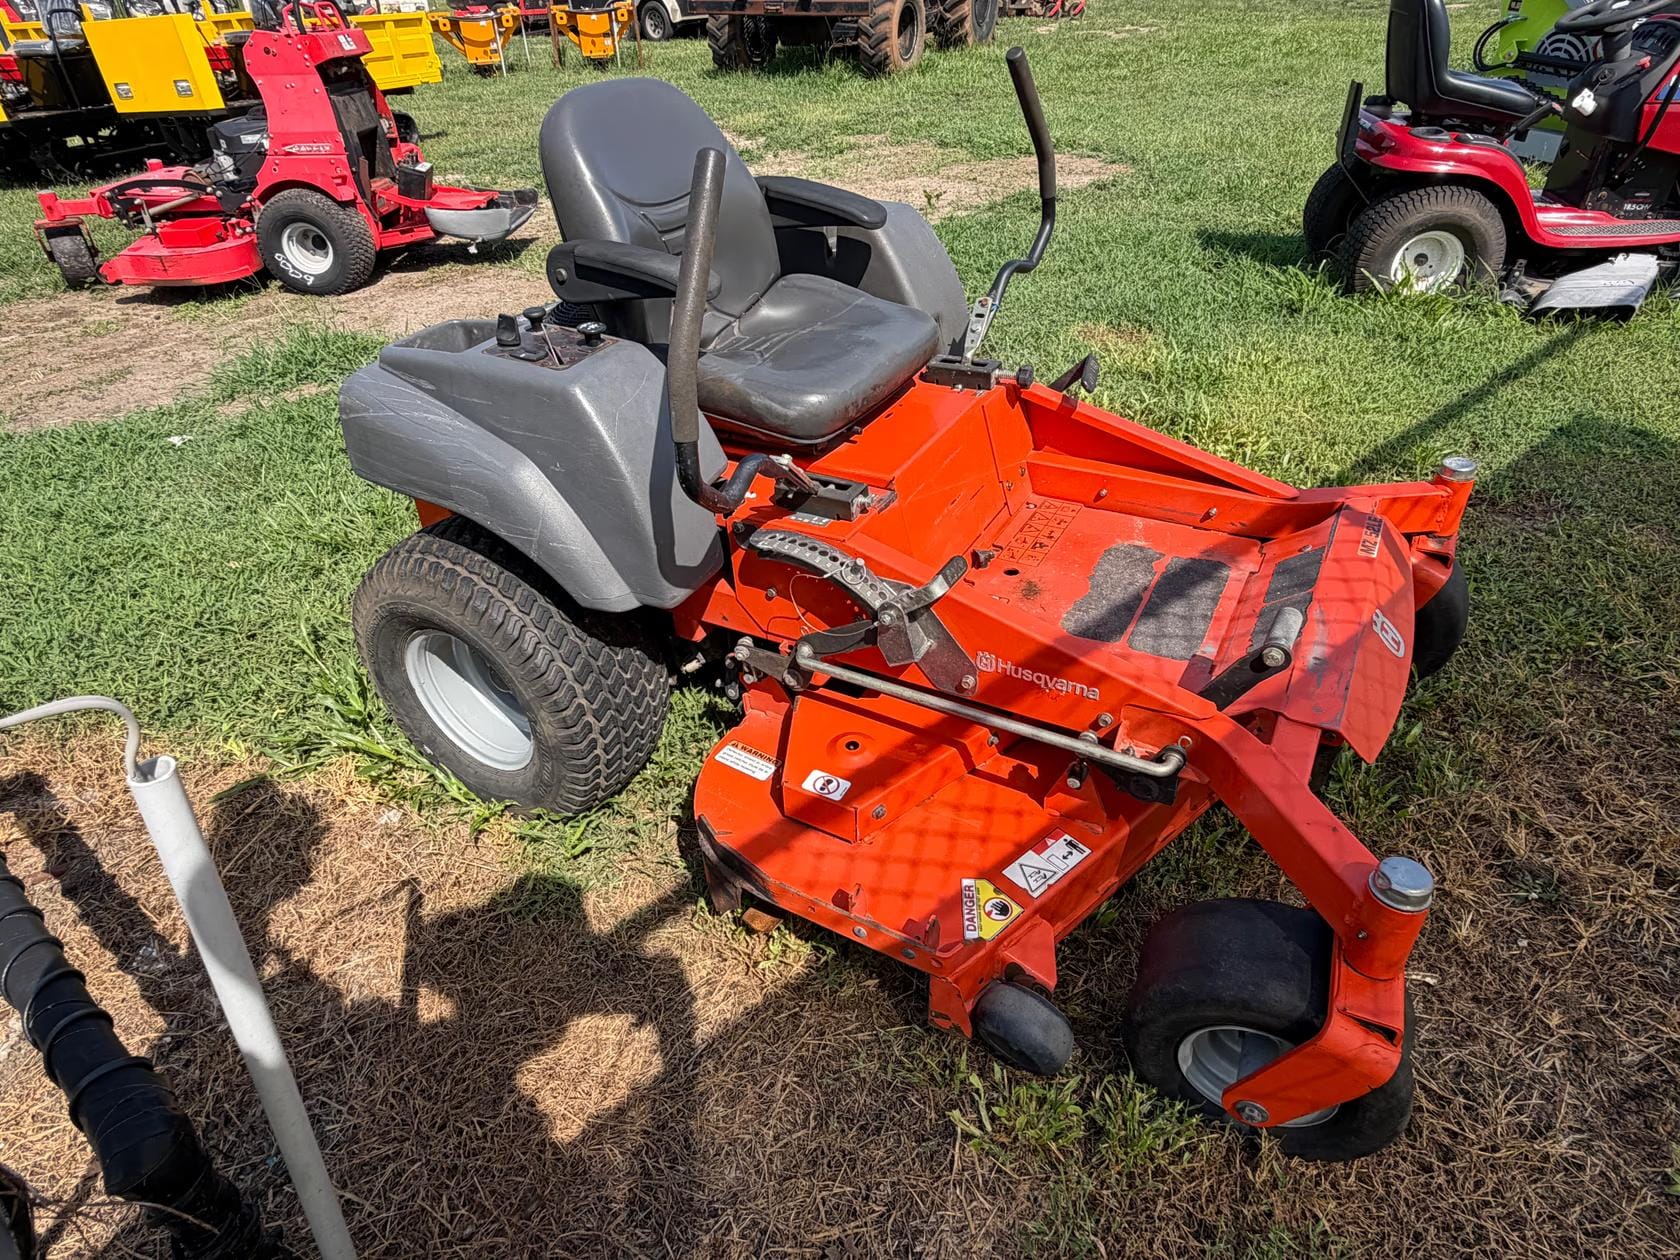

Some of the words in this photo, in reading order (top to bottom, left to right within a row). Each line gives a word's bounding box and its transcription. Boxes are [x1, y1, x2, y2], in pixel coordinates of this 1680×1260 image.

[996, 657, 1100, 701] Husqvarna
[740, 745, 782, 767] WARNING
[963, 884, 977, 932] DANGER
